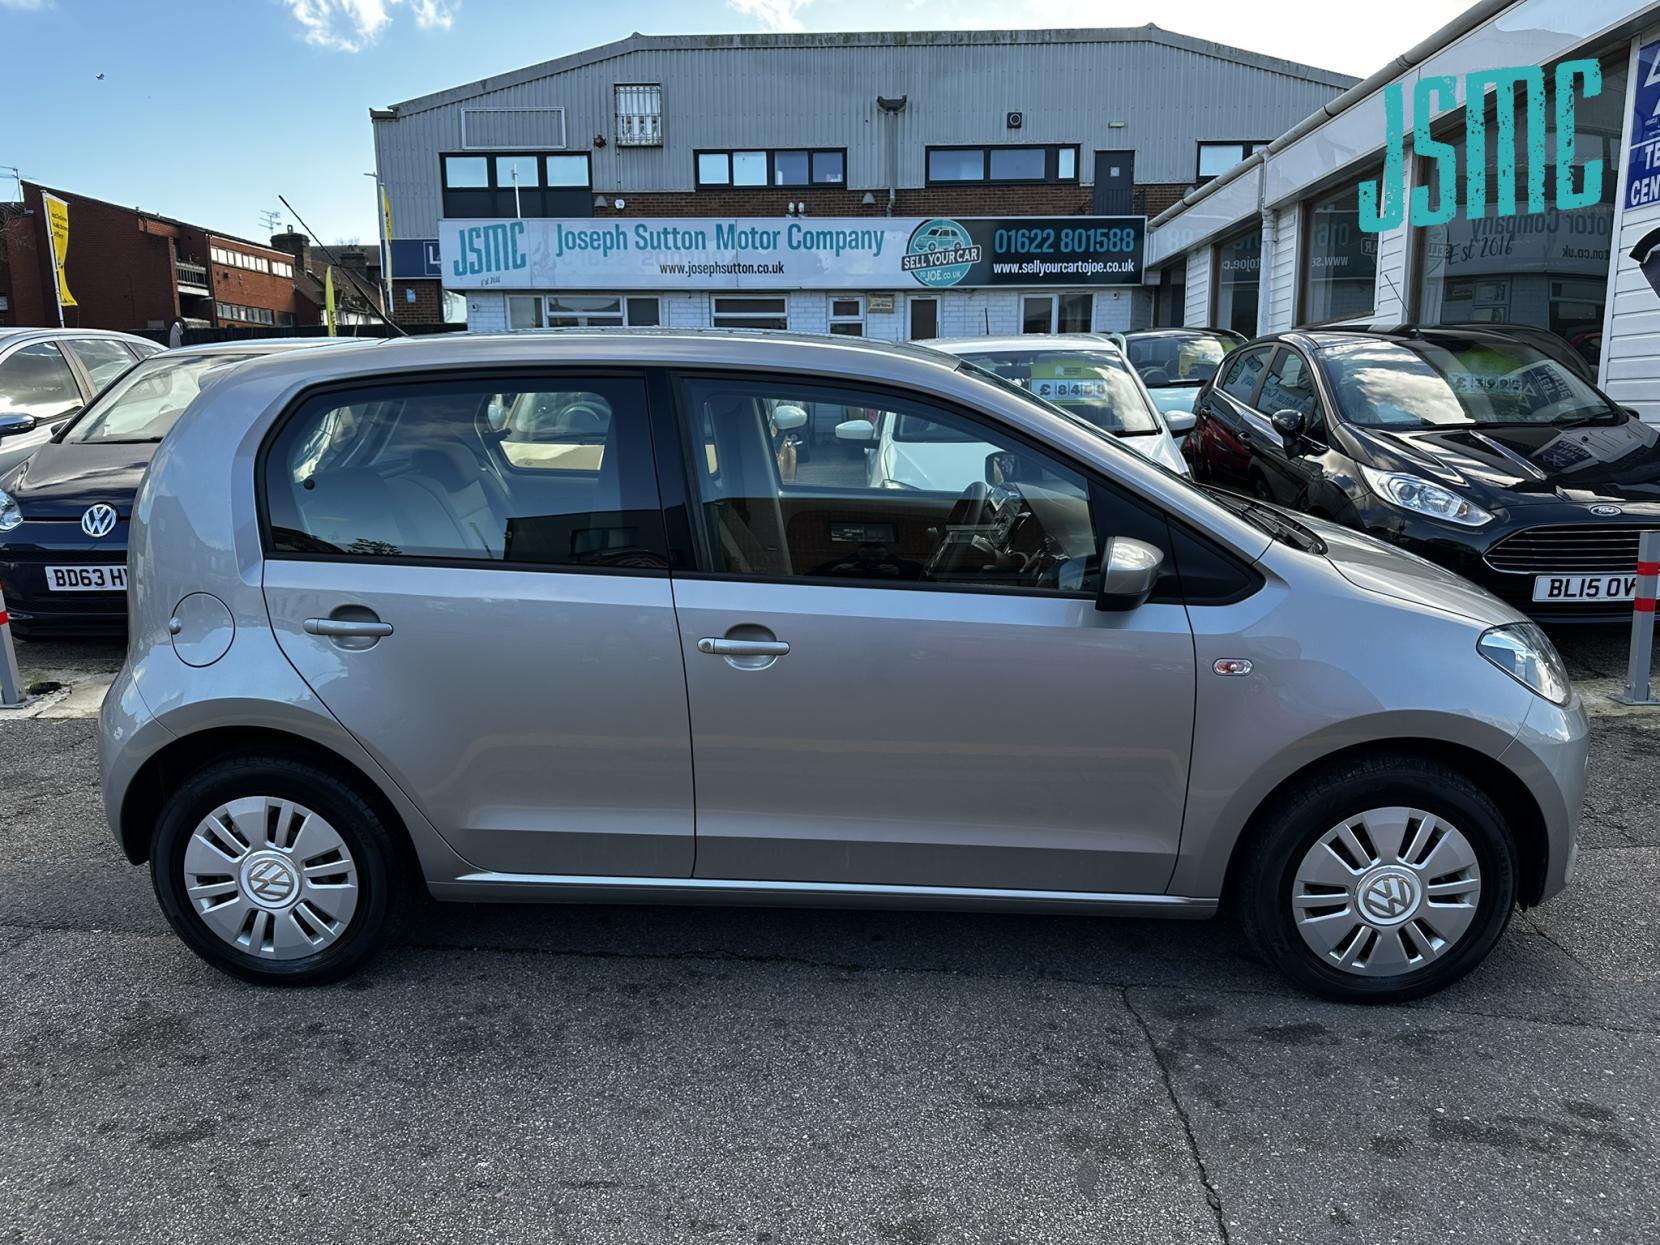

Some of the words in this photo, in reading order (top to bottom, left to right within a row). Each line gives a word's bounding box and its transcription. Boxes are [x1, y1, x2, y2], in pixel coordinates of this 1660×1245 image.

[453, 221, 526, 277] JSMC
[555, 223, 628, 257] Joseph
[634, 223, 706, 250] Sutton
[715, 223, 781, 250] Motor
[787, 223, 885, 257] Company
[994, 228, 1055, 254] 01622
[1060, 228, 1135, 253] 801588
[659, 261, 785, 278] www.josephsutton.co.uk
[904, 255, 927, 270] SELL
[928, 251, 956, 267] YOUR
[956, 248, 978, 264] CAR
[993, 259, 1135, 277] www.sellyourcartojoe.co.uk
[54, 569, 105, 586] BD63
[110, 569, 127, 586] H
[1548, 578, 1599, 598] BL15
